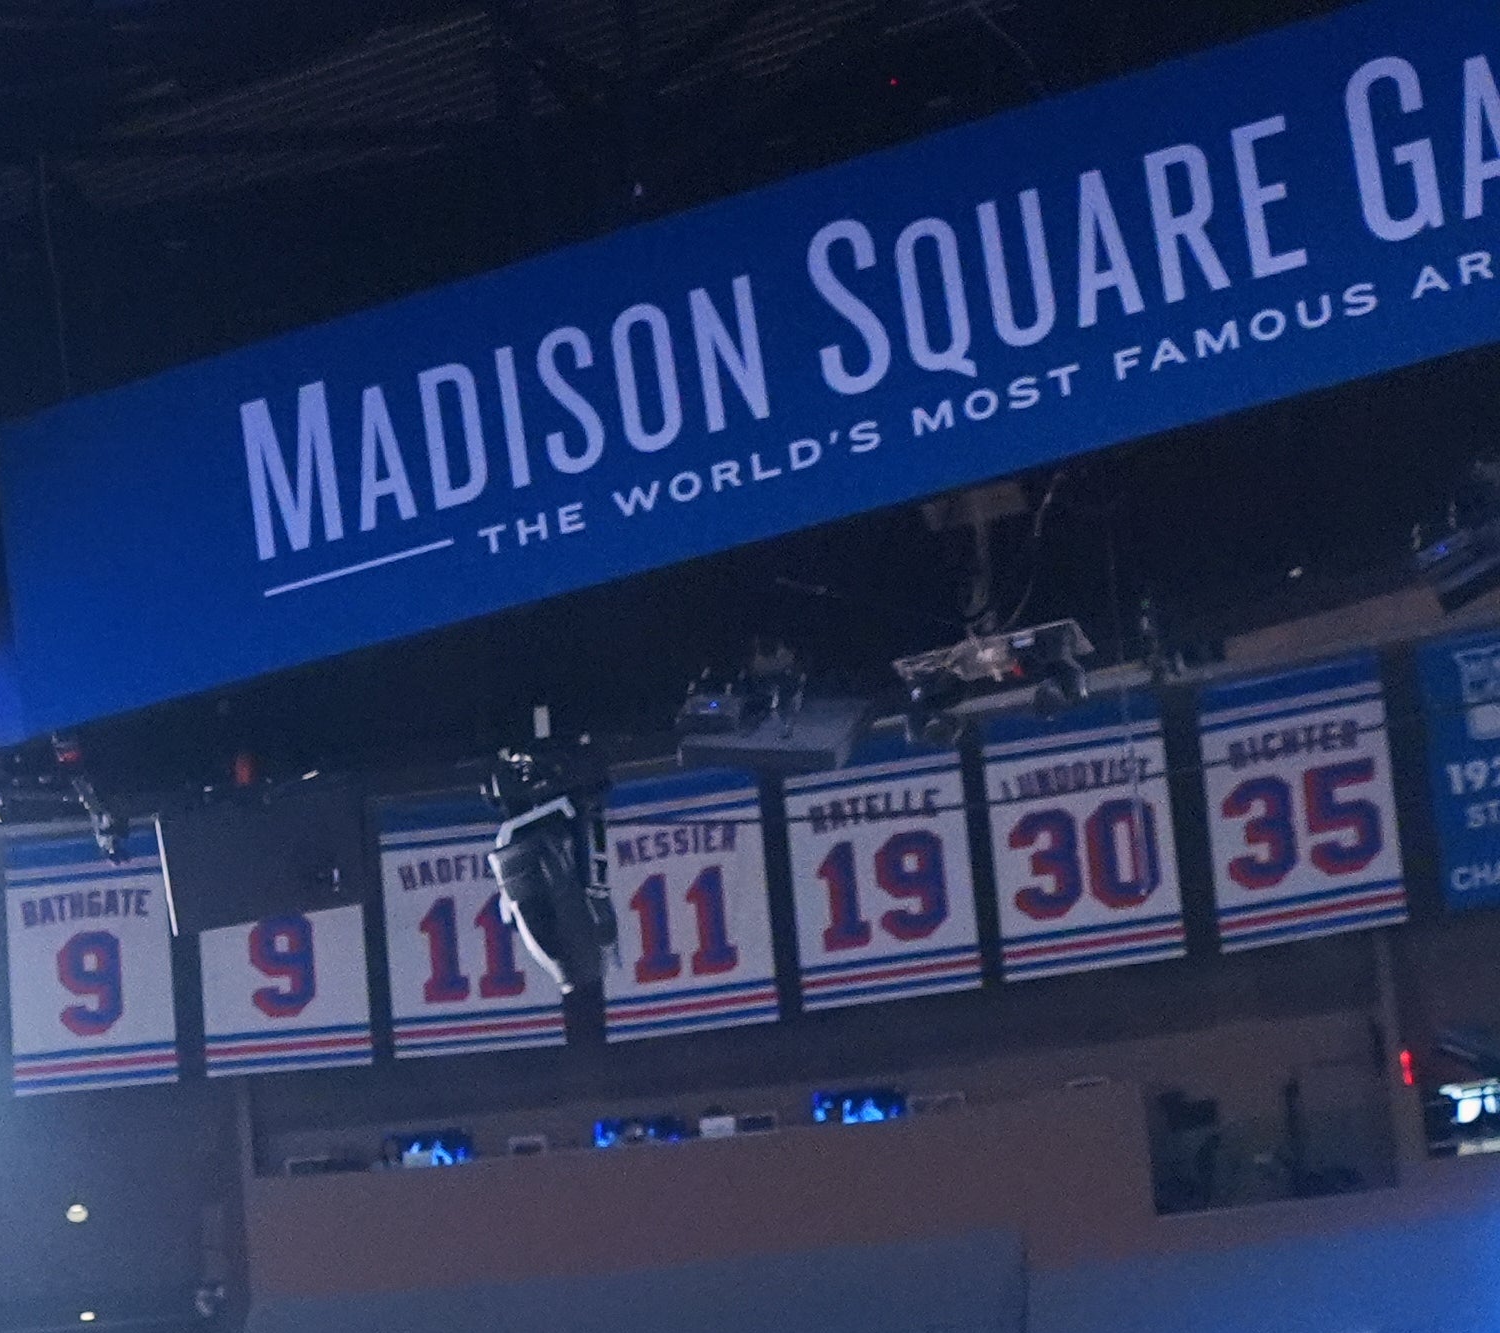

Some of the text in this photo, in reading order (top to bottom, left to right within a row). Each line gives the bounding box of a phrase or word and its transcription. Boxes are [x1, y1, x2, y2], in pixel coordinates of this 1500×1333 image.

[240, 276, 771, 560] MADISON
[806, 114, 1309, 397] SQUARE
[477, 502, 586, 556] THE
[613, 419, 884, 521] WORLD'S
[911, 363, 1082, 436] MOST
[1112, 278, 1380, 383] FAMOUS
[1008, 798, 1162, 921] 30
[1220, 757, 1385, 891] 35
[21, 889, 153, 929] BATHGATE
[420, 892, 526, 1004] 11
[630, 865, 739, 984] 11
[816, 829, 951, 952] 19
[56, 929, 124, 1037] 9
[249, 914, 318, 1019] 9
